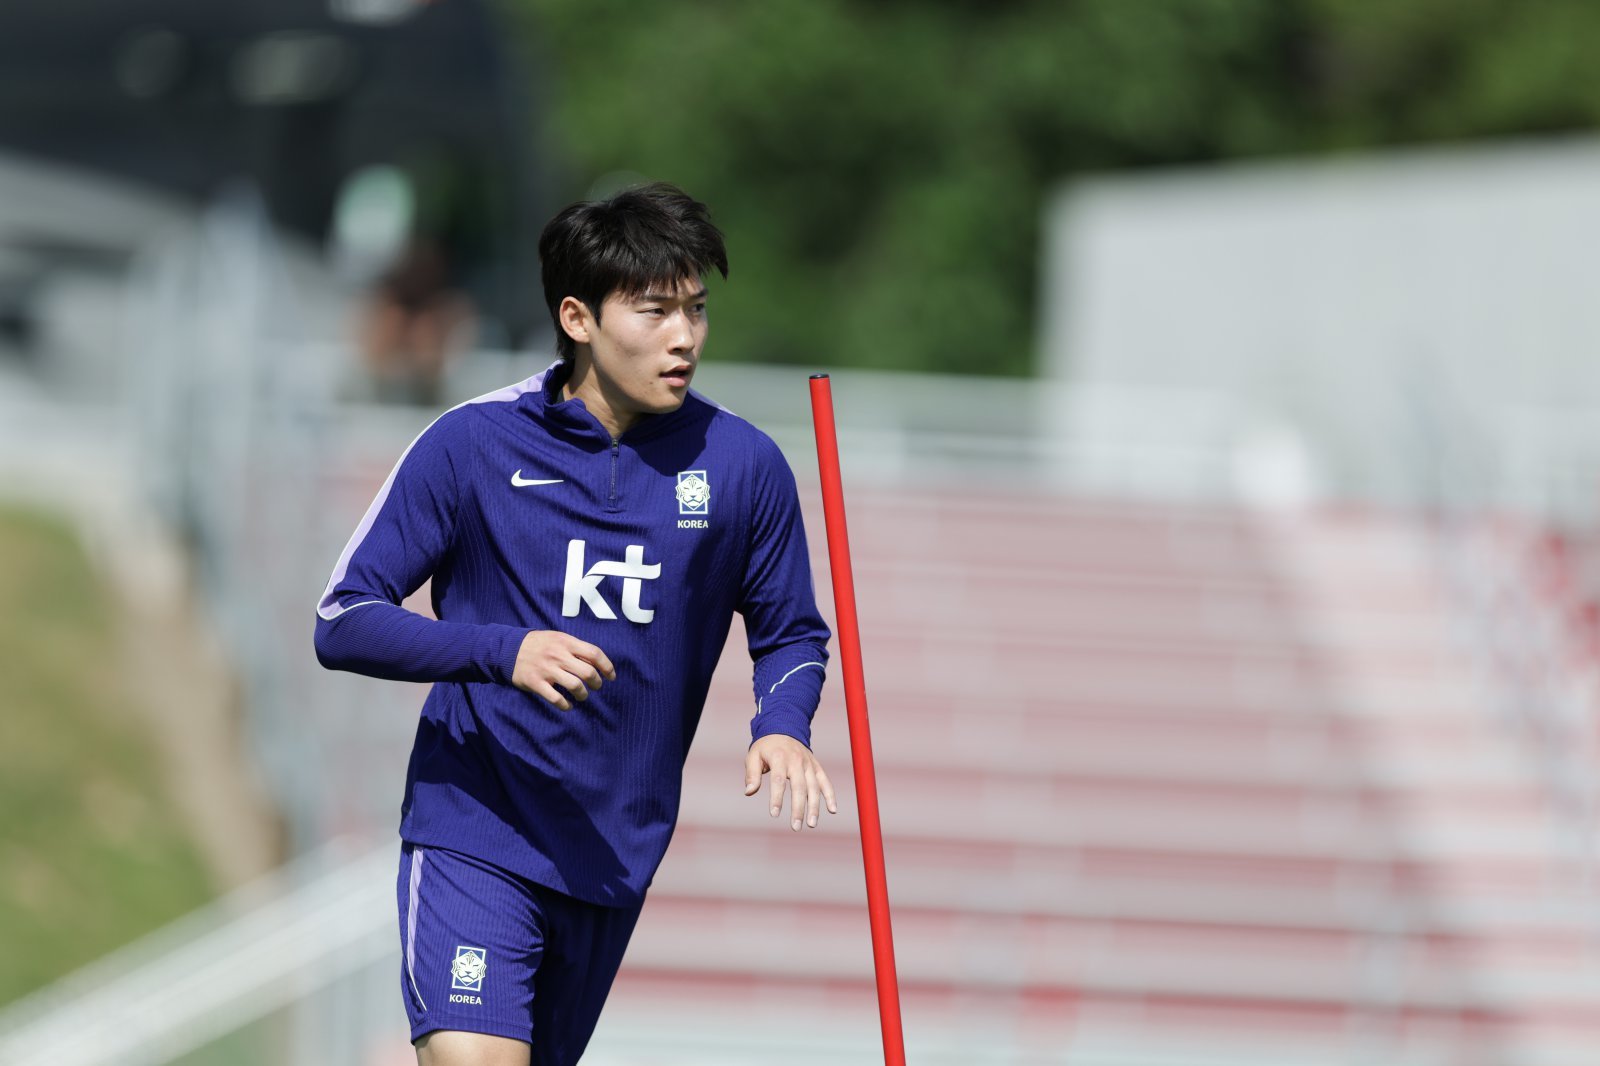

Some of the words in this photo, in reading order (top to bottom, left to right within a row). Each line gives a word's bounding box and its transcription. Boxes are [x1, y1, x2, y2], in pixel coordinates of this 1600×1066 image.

[677, 519, 709, 529] KOREA
[562, 539, 661, 624] kt
[449, 994, 482, 1005] KOREA
